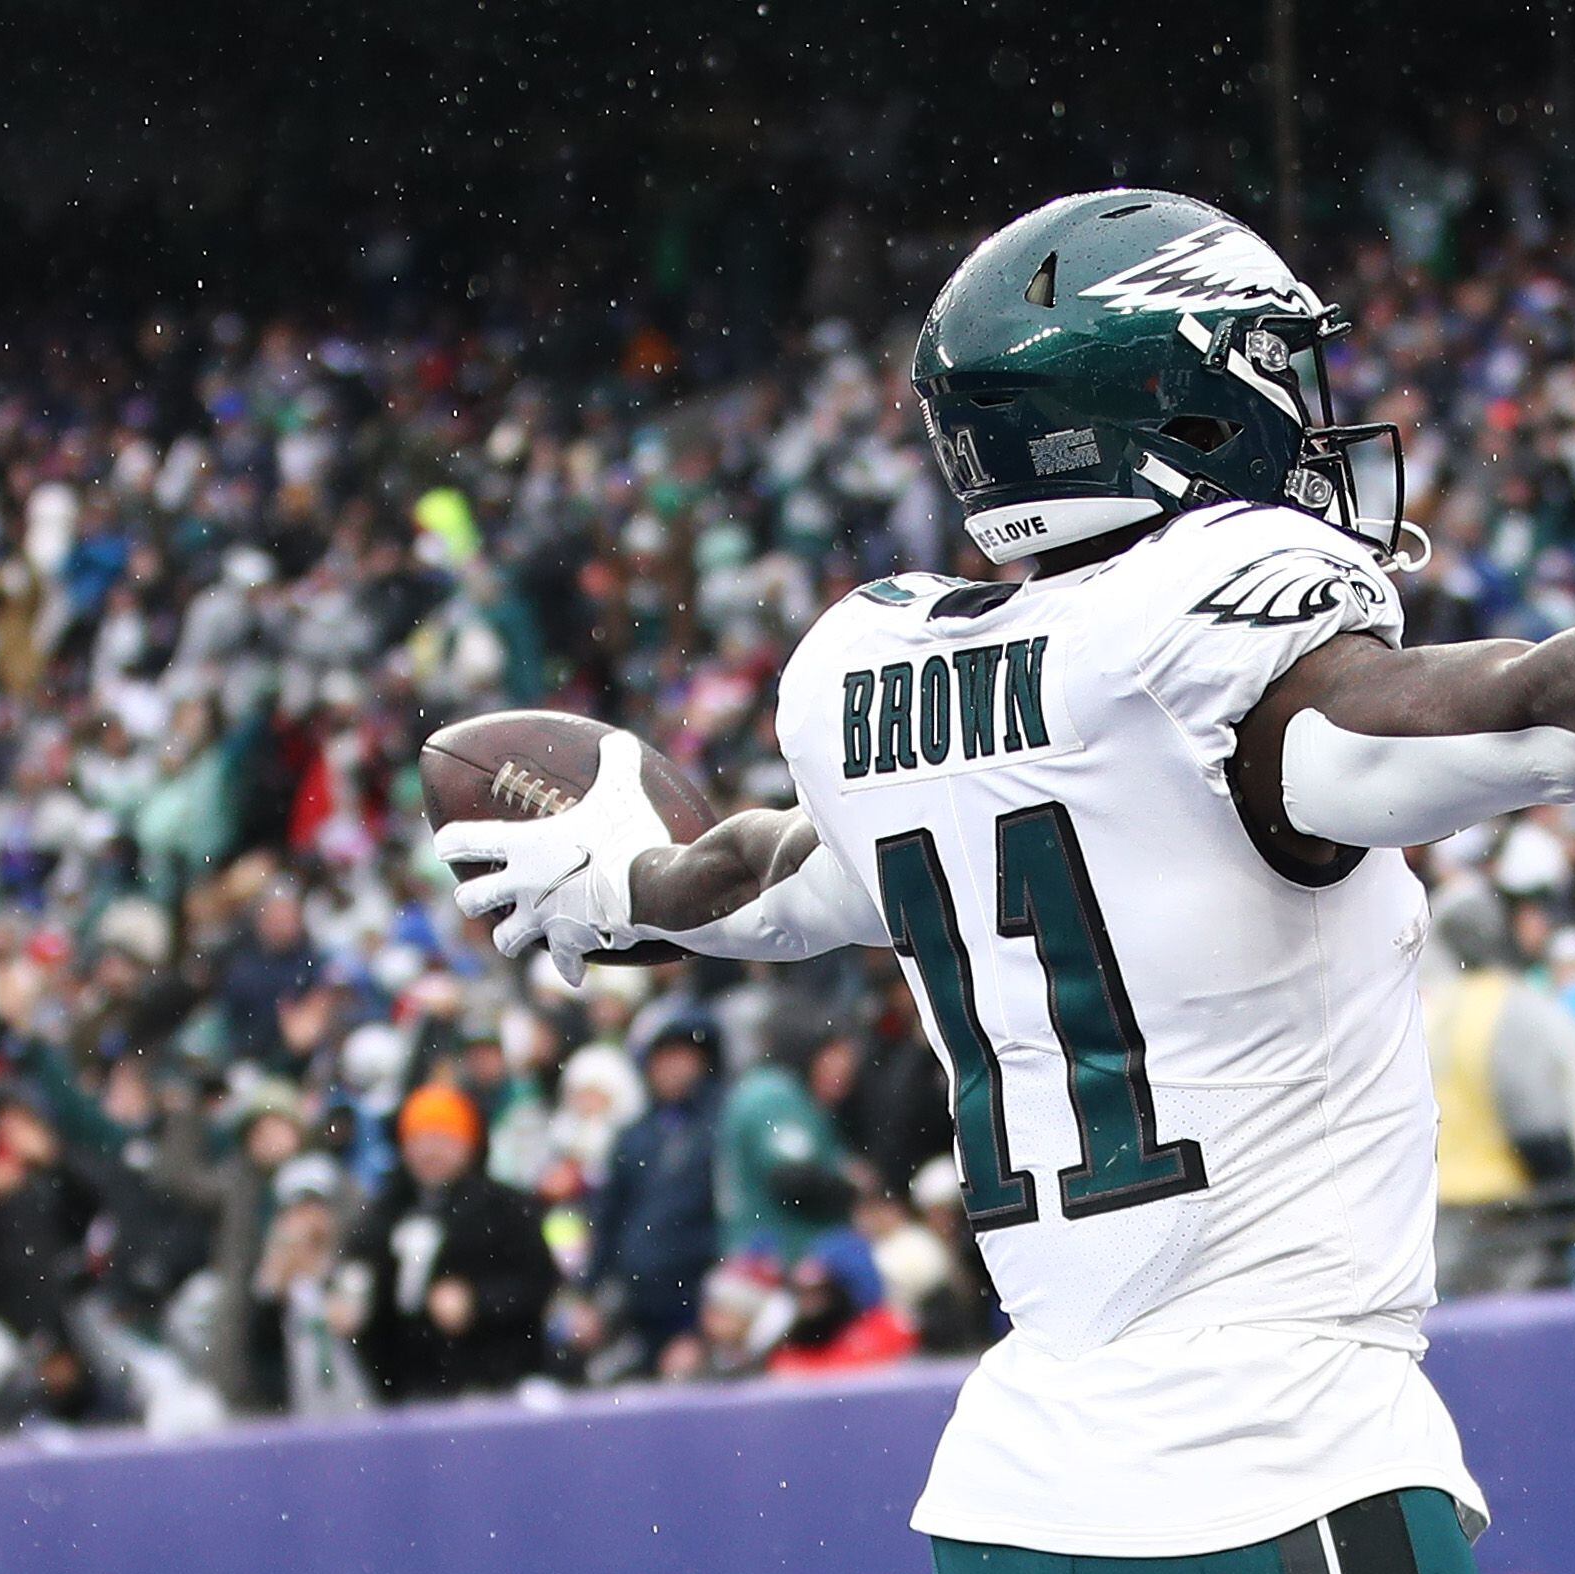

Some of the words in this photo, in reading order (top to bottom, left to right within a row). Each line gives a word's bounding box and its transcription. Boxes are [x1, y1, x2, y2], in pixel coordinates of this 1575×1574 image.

[993, 515, 1048, 544] LOVE
[842, 635, 1051, 778] BROWN
[875, 800, 1210, 1233] 11
